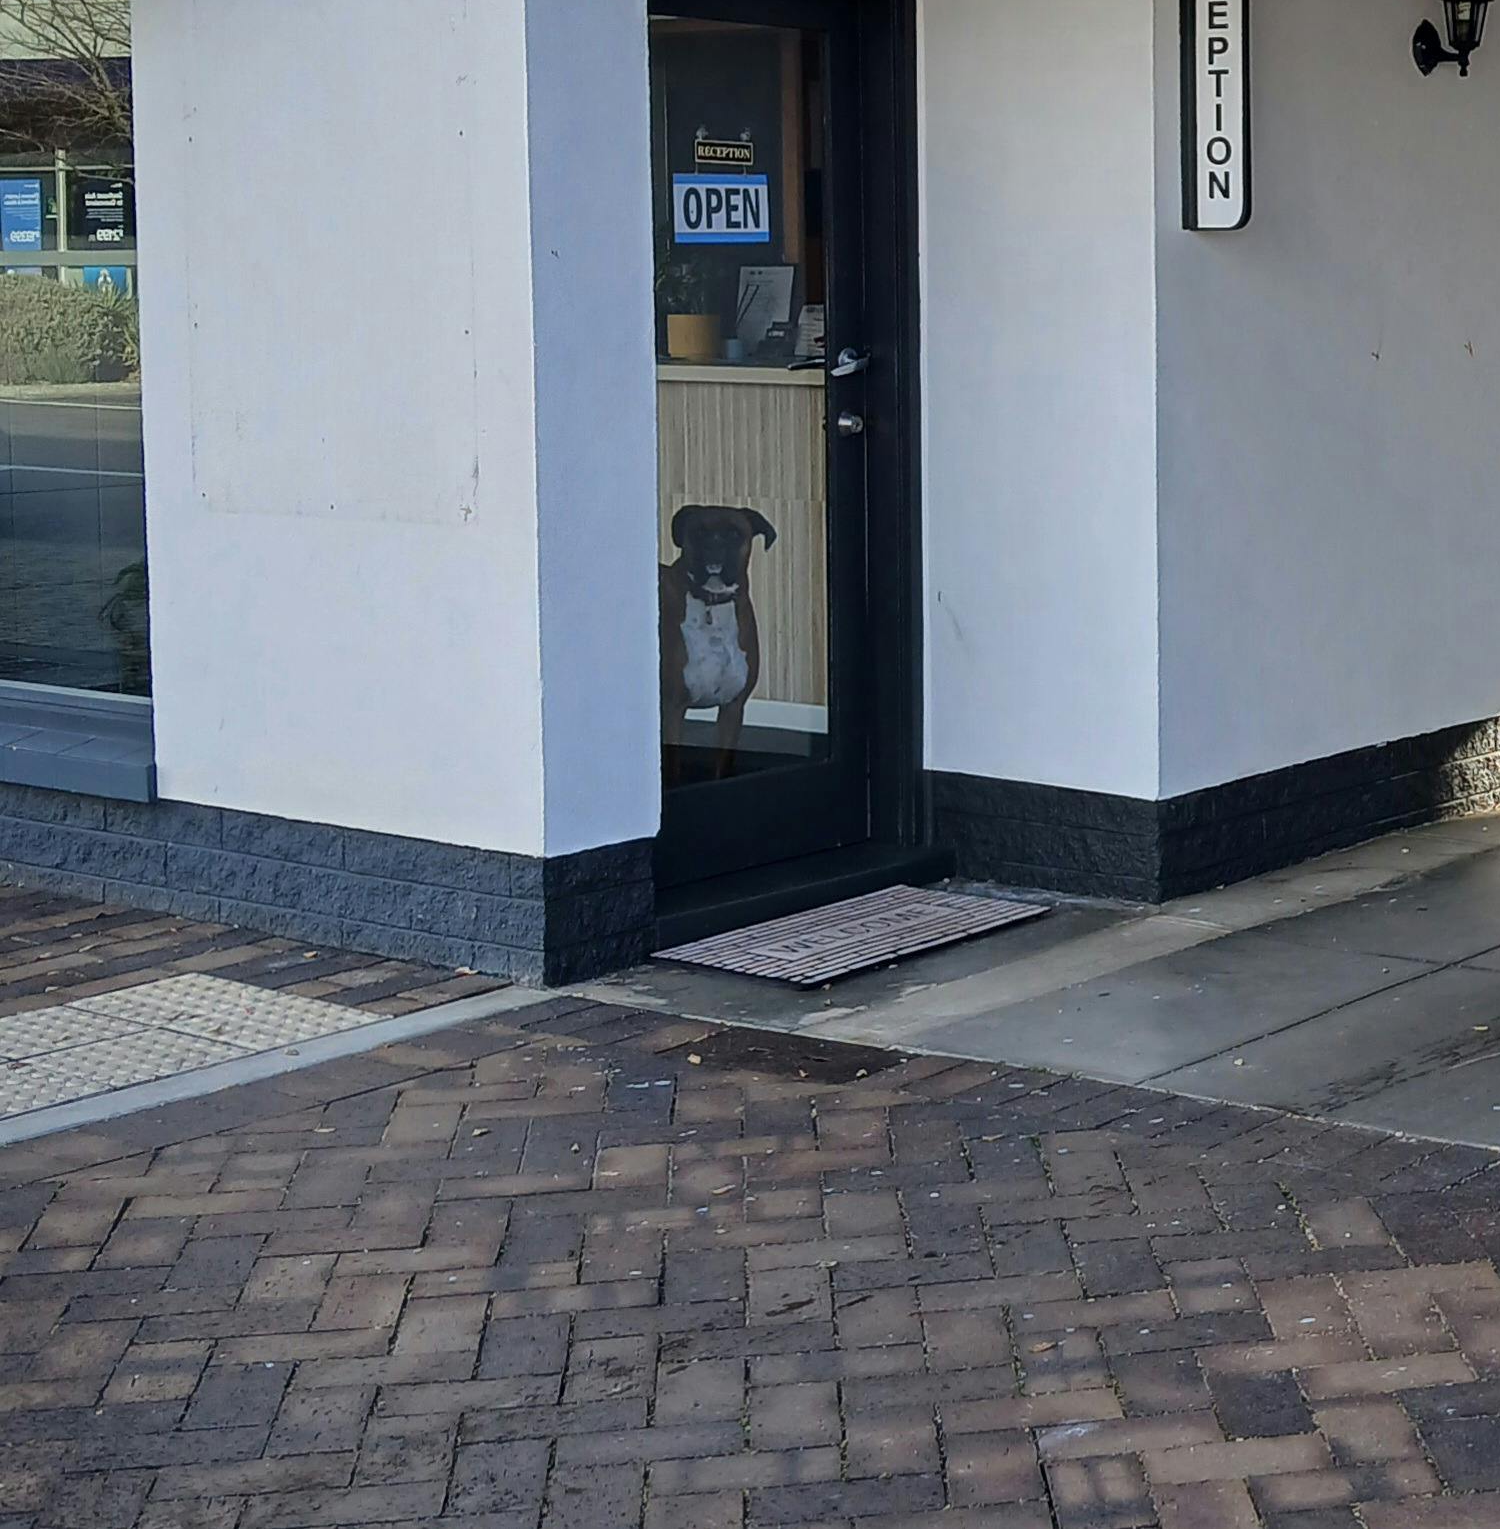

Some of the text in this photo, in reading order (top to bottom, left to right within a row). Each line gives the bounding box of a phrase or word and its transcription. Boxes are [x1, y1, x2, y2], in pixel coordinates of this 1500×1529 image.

[697, 144, 751, 159] RECEPTION
[683, 187, 760, 229] OPEN
[767, 907, 938, 953] WELCOME
